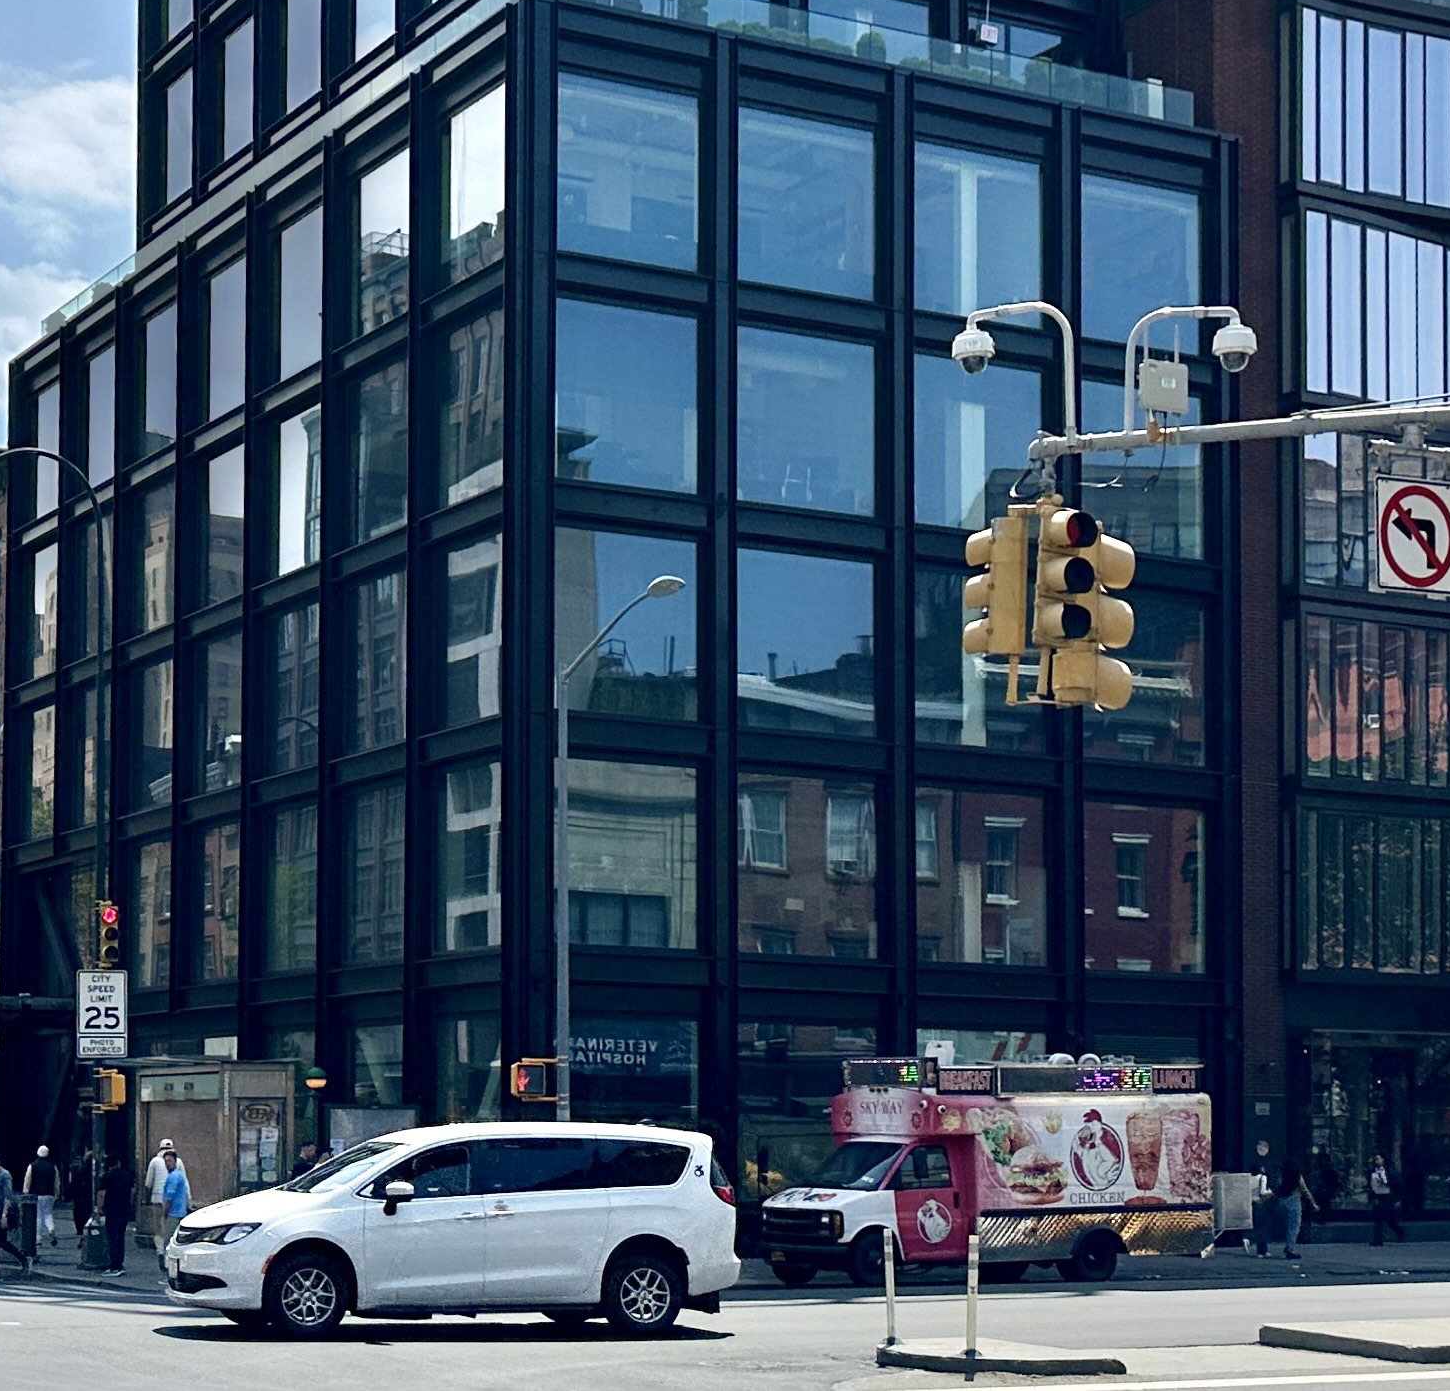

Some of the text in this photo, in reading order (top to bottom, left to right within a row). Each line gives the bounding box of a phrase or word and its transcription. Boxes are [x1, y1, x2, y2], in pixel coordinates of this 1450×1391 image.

[91, 975, 111, 983] CITY
[88, 985, 115, 993] SPEED
[90, 995, 113, 1003] LIMIT
[84, 1006, 120, 1029] 25
[939, 1070, 991, 1091] BREAKFAST
[1153, 1069, 1195, 1089] LUNCH
[1070, 1191, 1125, 1205] CHICKEN
